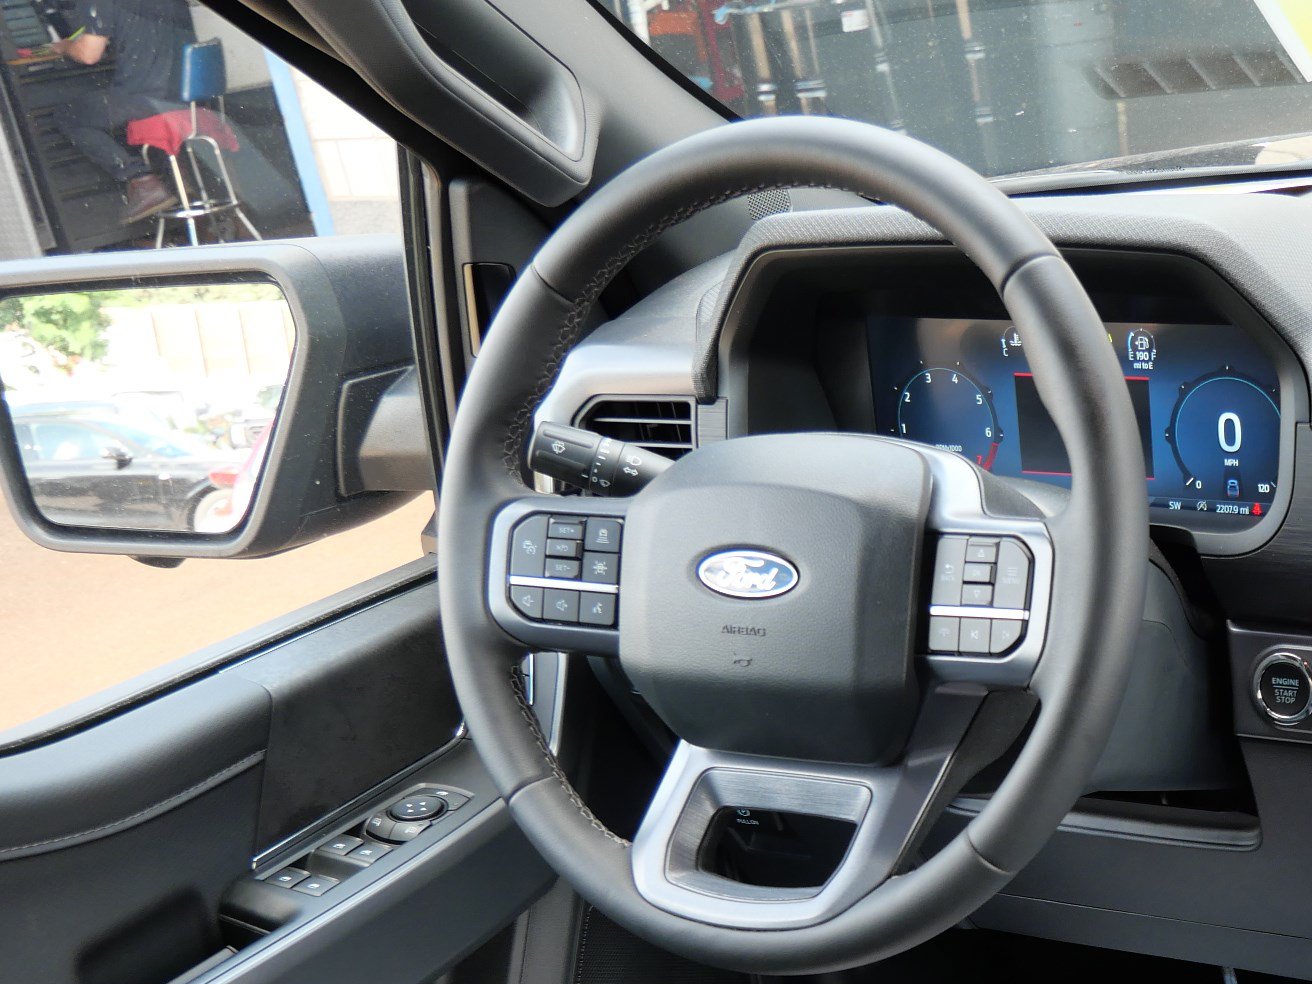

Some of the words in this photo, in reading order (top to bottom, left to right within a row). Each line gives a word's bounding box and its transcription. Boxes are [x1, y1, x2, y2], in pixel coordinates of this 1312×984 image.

[1128, 352, 1134, 361] E
[1136, 351, 1149, 361] 190
[1151, 352, 1157, 361] F
[925, 373, 932, 383] 3
[951, 374, 959, 384] 4
[904, 392, 911, 402] 2
[976, 395, 983, 405] 5
[901, 424, 907, 434] 1
[985, 427, 992, 438] 6
[1217, 411, 1242, 453] 0
[1224, 458, 1239, 467] MPH
[1195, 480, 1202, 489] 0
[1258, 484, 1270, 493] 120
[1168, 501, 1182, 510] SW
[1239, 506, 1250, 515] mi
[704, 557, 779, 591] Ford
[1271, 677, 1300, 687] ENGINE
[1274, 689, 1298, 698] START
[1275, 696, 1296, 705] STOP
